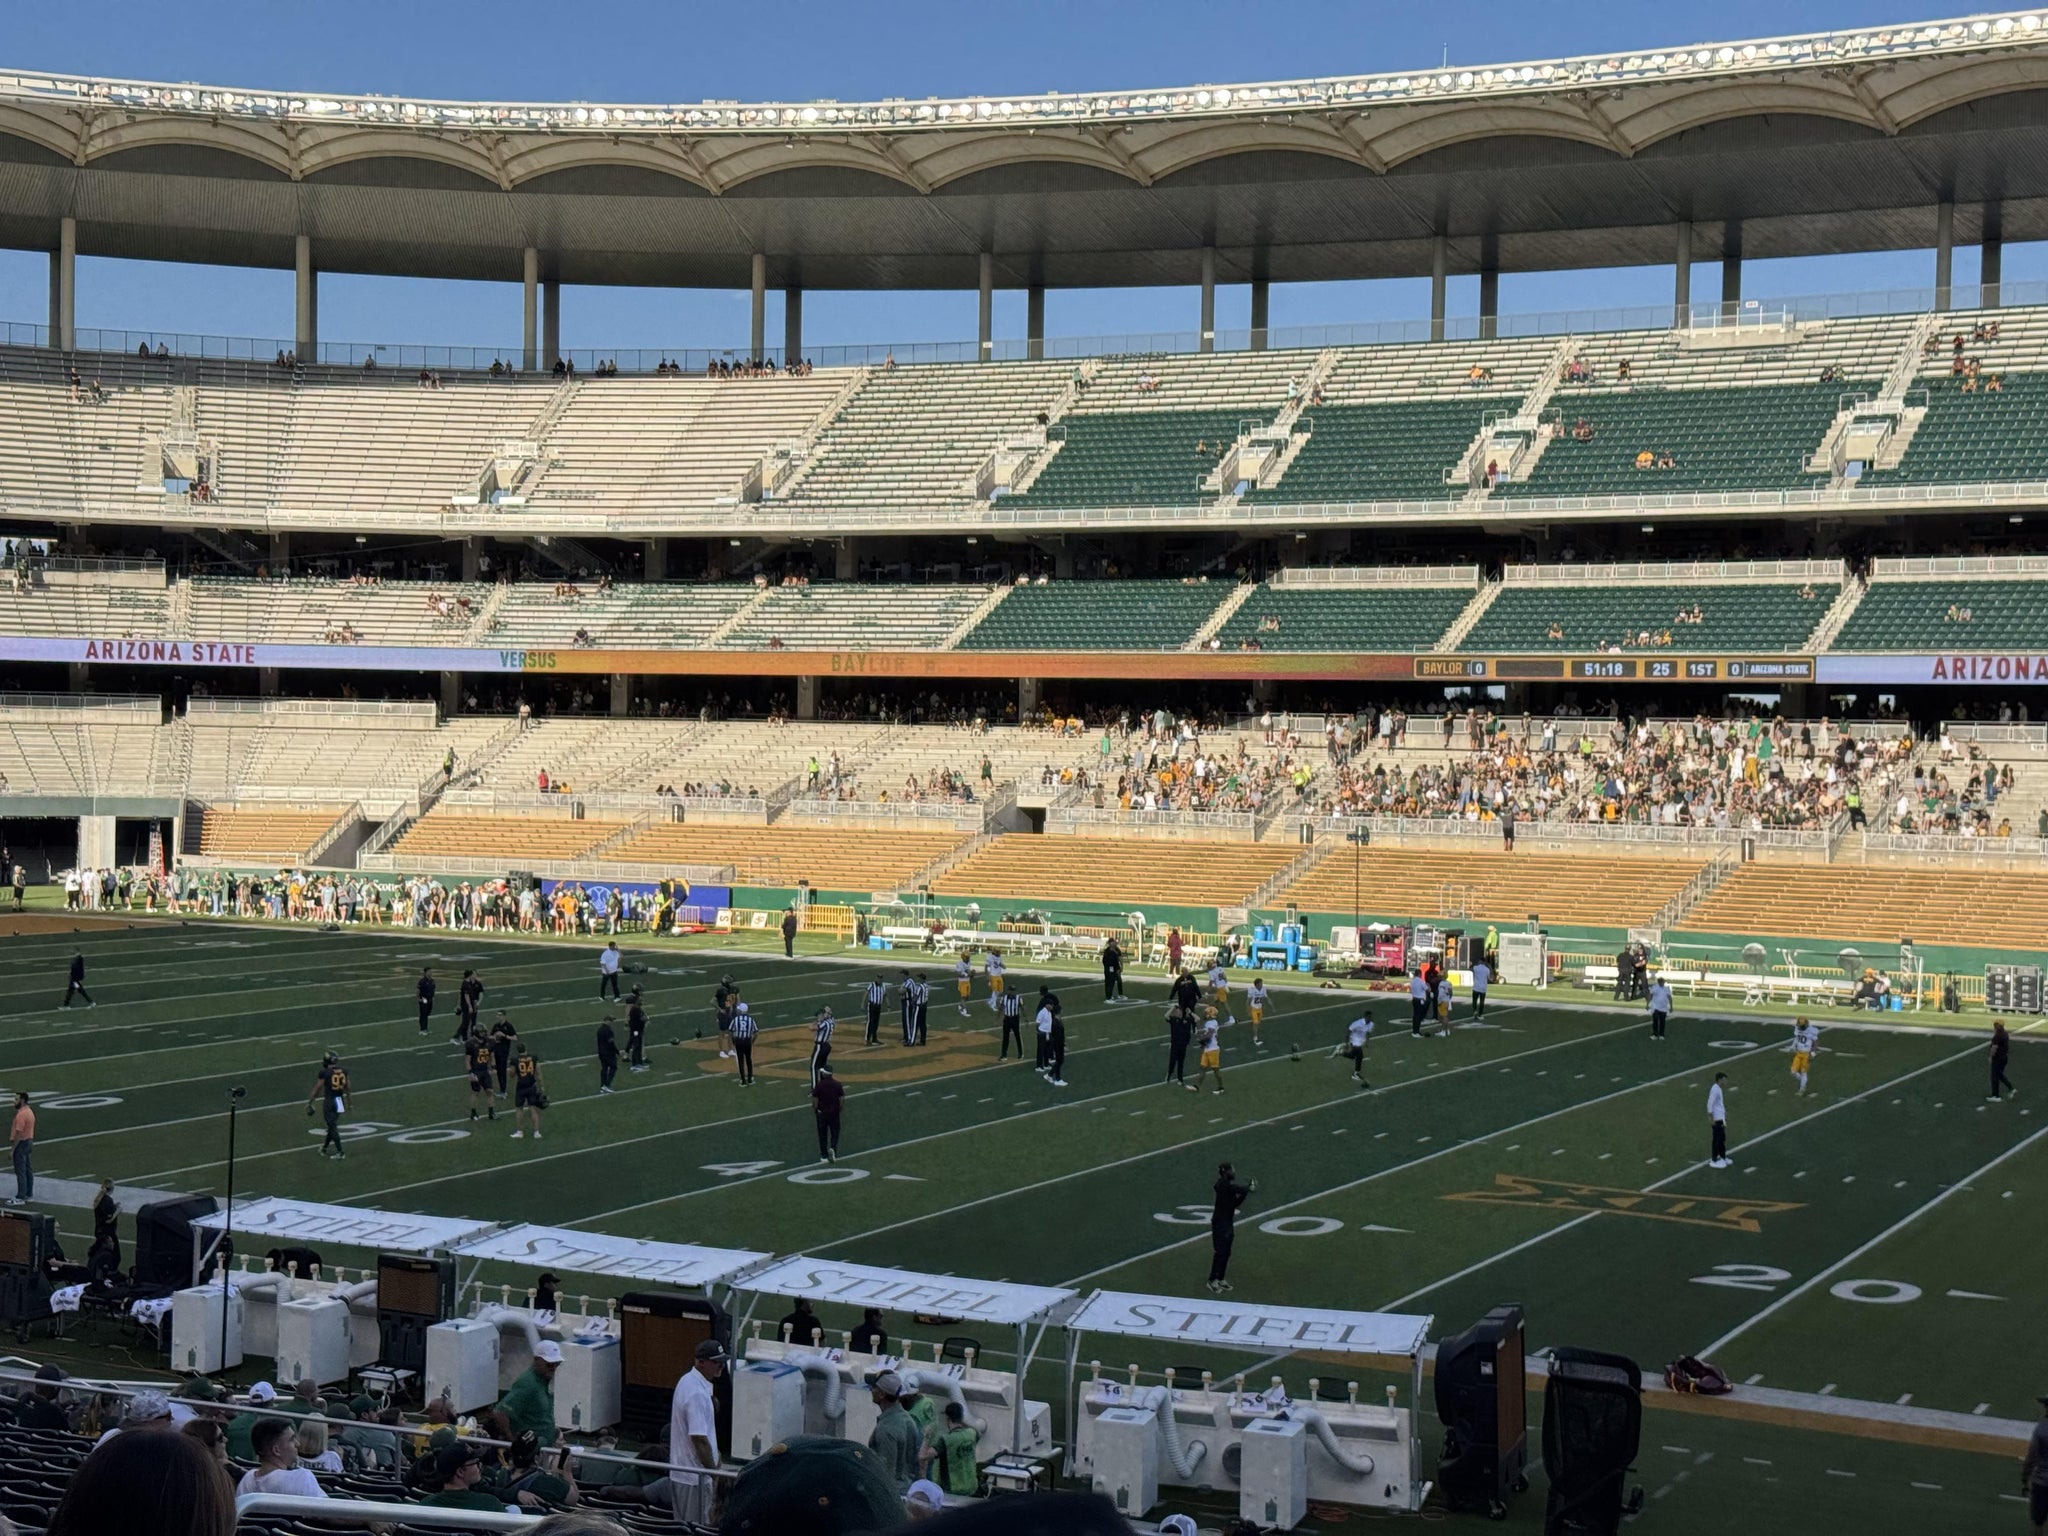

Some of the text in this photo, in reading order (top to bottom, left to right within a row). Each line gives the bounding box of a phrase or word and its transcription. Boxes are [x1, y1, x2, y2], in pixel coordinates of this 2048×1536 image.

[86, 641, 255, 664] ARIZONA STATE
[500, 651, 556, 668] VERSUS
[1423, 662, 1483, 674] BAYLOR 0
[1652, 663, 1670, 676] 25
[1690, 663, 1713, 676] 1ST
[1731, 663, 1808, 676] 0 ARIZONA STATE
[1932, 657, 2048, 680] ARIZONA
[740, 1021, 747, 1031] R
[519, 1061, 534, 1078] 94
[235, 1208, 428, 1244] STIFEL
[498, 1237, 704, 1277] STIFEL
[779, 1269, 1004, 1314] STIFEL
[1114, 1304, 1376, 1345] STIFEL
